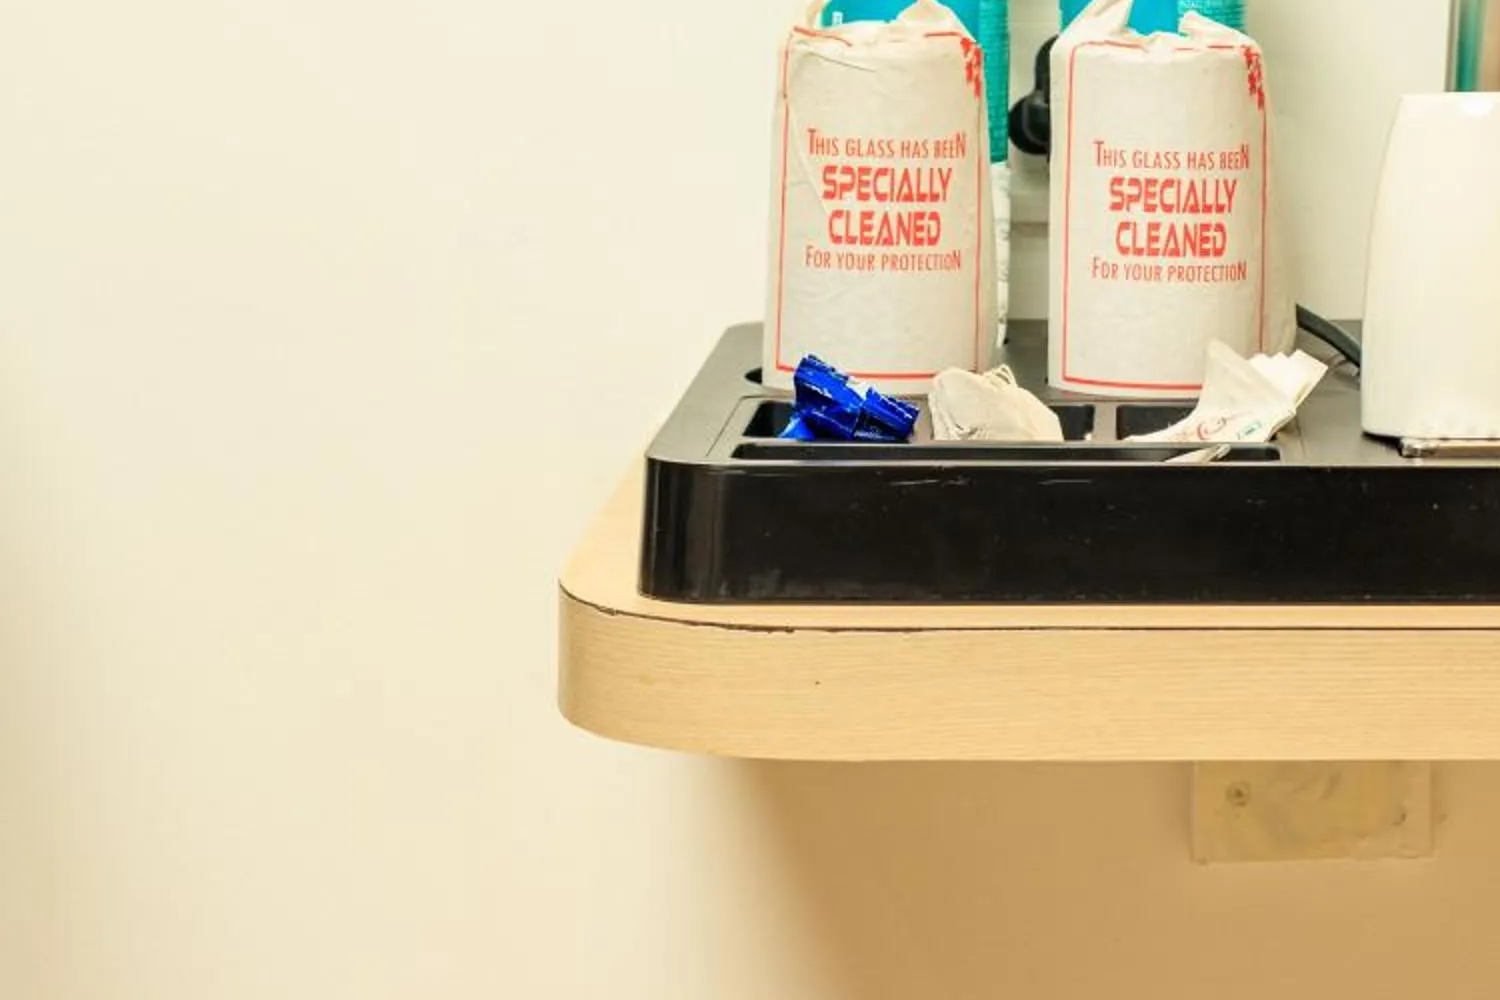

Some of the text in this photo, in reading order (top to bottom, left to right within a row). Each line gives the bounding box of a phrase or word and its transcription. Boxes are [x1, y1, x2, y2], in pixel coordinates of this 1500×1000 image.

[807, 128, 967, 159] THIS GLASS HAS BEEN
[1093, 140, 1249, 170] THIS GLASS HAS BEEN
[822, 165, 953, 202] SPECIALLY
[1108, 176, 1237, 214] SPECIALLY
[828, 209, 942, 246] CLEANED
[1115, 221, 1227, 257] CLEANED
[805, 245, 961, 271] FOR YOUR PROTECTION
[1091, 257, 1247, 282] FOR YOUR PROTECTION
